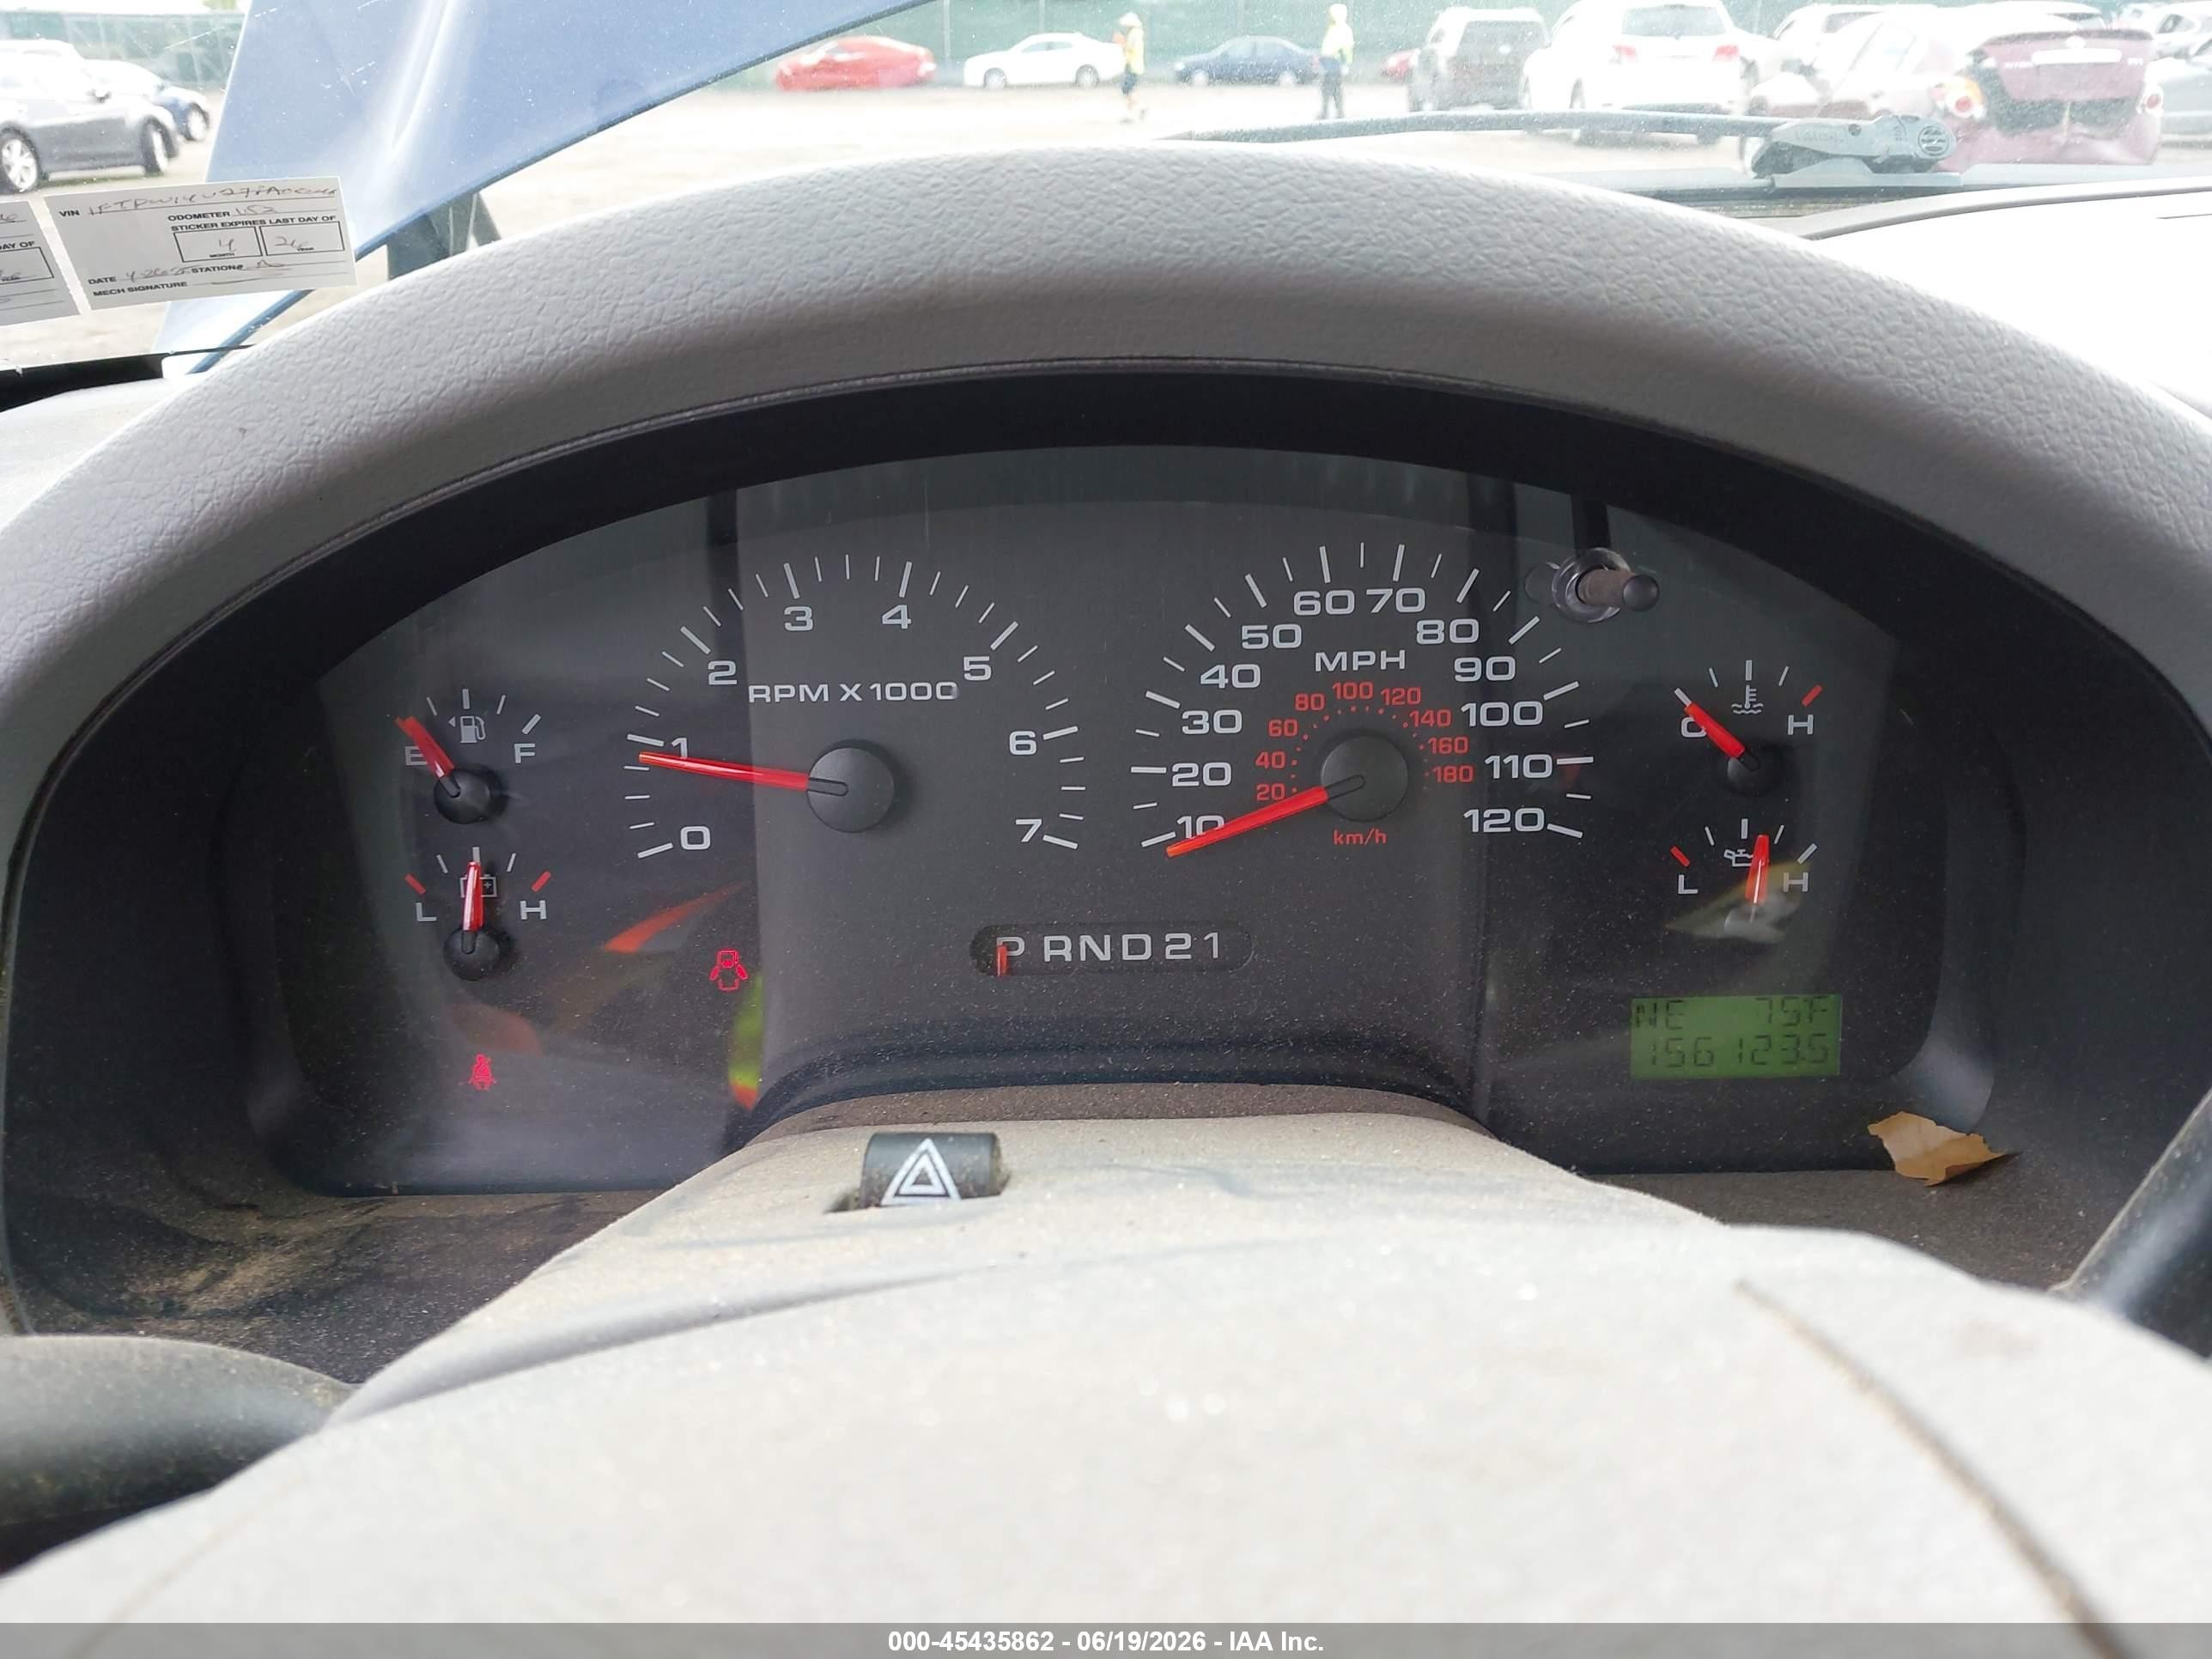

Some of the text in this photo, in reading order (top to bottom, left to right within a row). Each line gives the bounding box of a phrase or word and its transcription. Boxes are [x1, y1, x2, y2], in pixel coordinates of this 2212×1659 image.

[167, 211, 230, 222] ODOMETER
[171, 222, 218, 232] STICKER
[222, 219, 266, 228] EXPIRES
[93, 281, 187, 296] MECH SIGNATURE
[1294, 590, 1354, 616] 60
[1366, 587, 1425, 613] 70
[784, 606, 813, 630] 3
[882, 605, 911, 629] 4
[1242, 623, 1302, 649] 50
[1416, 618, 1479, 644] 80
[963, 656, 992, 681] 5
[1315, 650, 1406, 672] MPH
[1454, 656, 1516, 682] 90
[708, 660, 737, 684] 2
[1200, 664, 1261, 689] 40
[749, 682, 959, 702] RPM X 1000
[1295, 693, 1325, 711] 80
[1333, 683, 1373, 701] 100
[1380, 687, 1421, 705] 120
[1182, 709, 1243, 734] 30
[1409, 709, 1451, 727] 140
[1461, 701, 1543, 727] 100
[1788, 714, 1814, 735] H
[1267, 719, 1298, 737] 60
[514, 743, 535, 763] F
[672, 738, 688, 757] 1
[1009, 731, 1037, 755] 6
[1428, 737, 1468, 755] 160
[404, 745, 428, 765] E
[1255, 751, 1285, 769] 40
[1171, 762, 1232, 787] 20
[1432, 765, 1474, 783] 180
[1484, 754, 1553, 780] 110
[1256, 783, 1285, 801] 20
[1016, 818, 1042, 842] 7
[1176, 815, 1224, 839] 10
[1463, 808, 1544, 833] 120
[680, 826, 710, 850] 0
[1333, 828, 1387, 846] km/h
[1678, 874, 1698, 895] L
[1784, 872, 1809, 892] H
[416, 902, 437, 921] L
[520, 900, 547, 920] H
